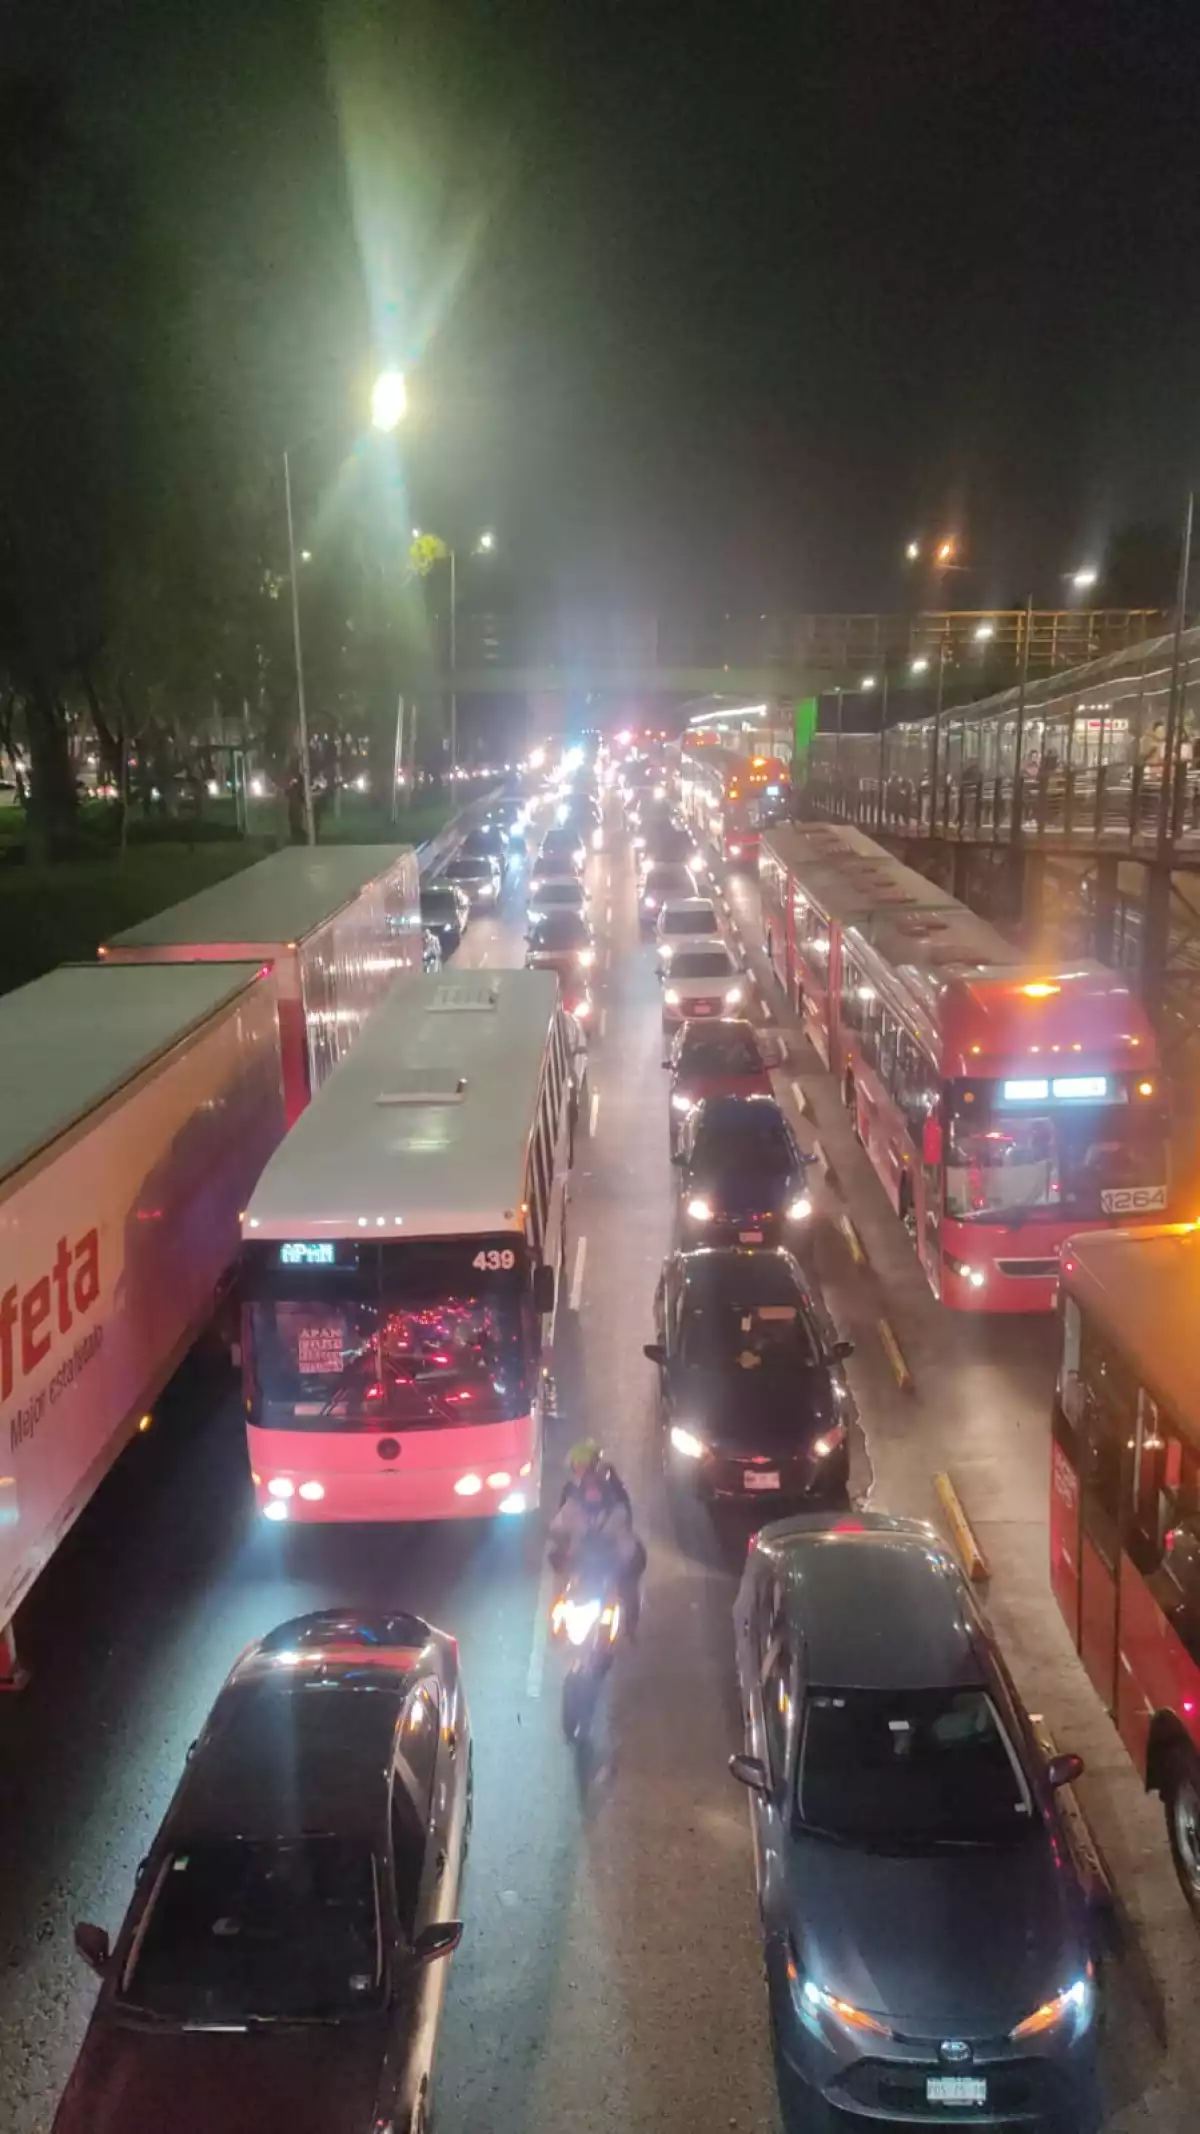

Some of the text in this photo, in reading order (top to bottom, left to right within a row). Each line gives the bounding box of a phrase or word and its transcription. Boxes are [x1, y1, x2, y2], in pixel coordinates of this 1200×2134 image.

[1104, 1188, 1165, 1211] 1264
[472, 1249, 515, 1271] 439
[0, 1228, 99, 1400] feta
[10, 1387, 47, 1452] Mejor
